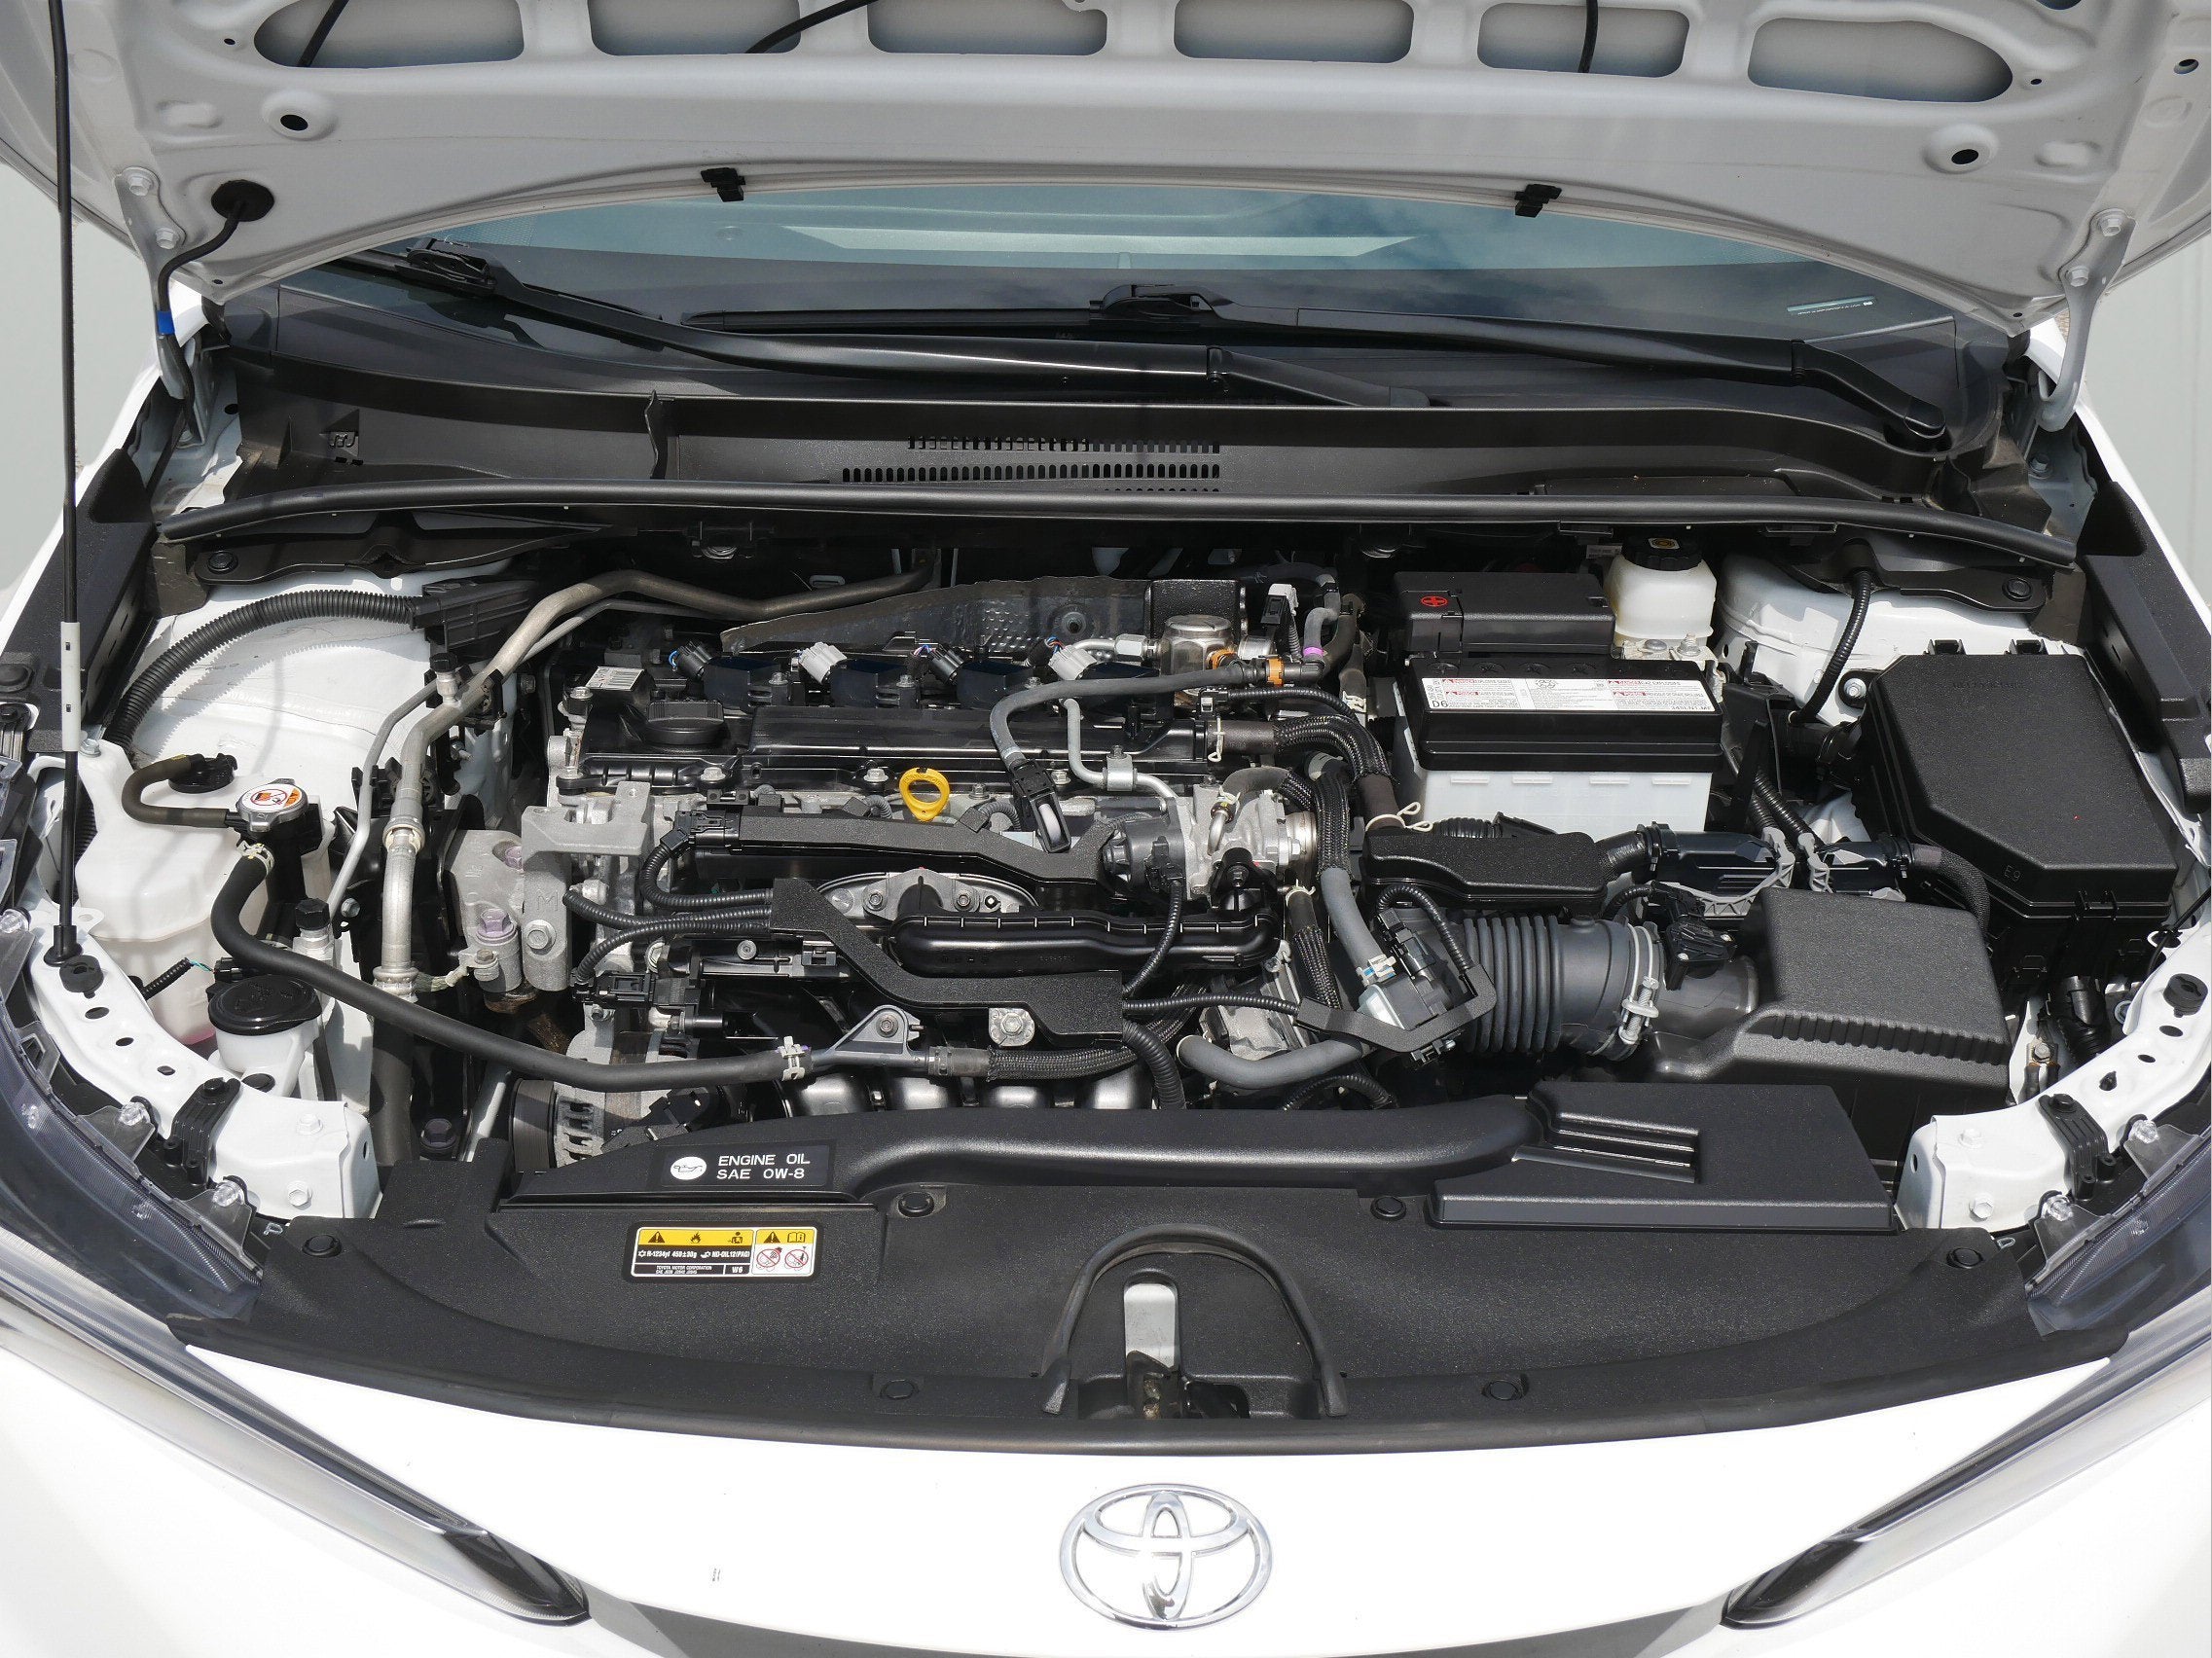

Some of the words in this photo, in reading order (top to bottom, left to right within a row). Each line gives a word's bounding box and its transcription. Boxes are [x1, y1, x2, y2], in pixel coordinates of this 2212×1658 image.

[718, 1154, 776, 1167] ENGINE
[786, 1153, 811, 1166] OIL
[716, 1169, 751, 1179] SAE
[763, 1168, 805, 1179] 0W-8
